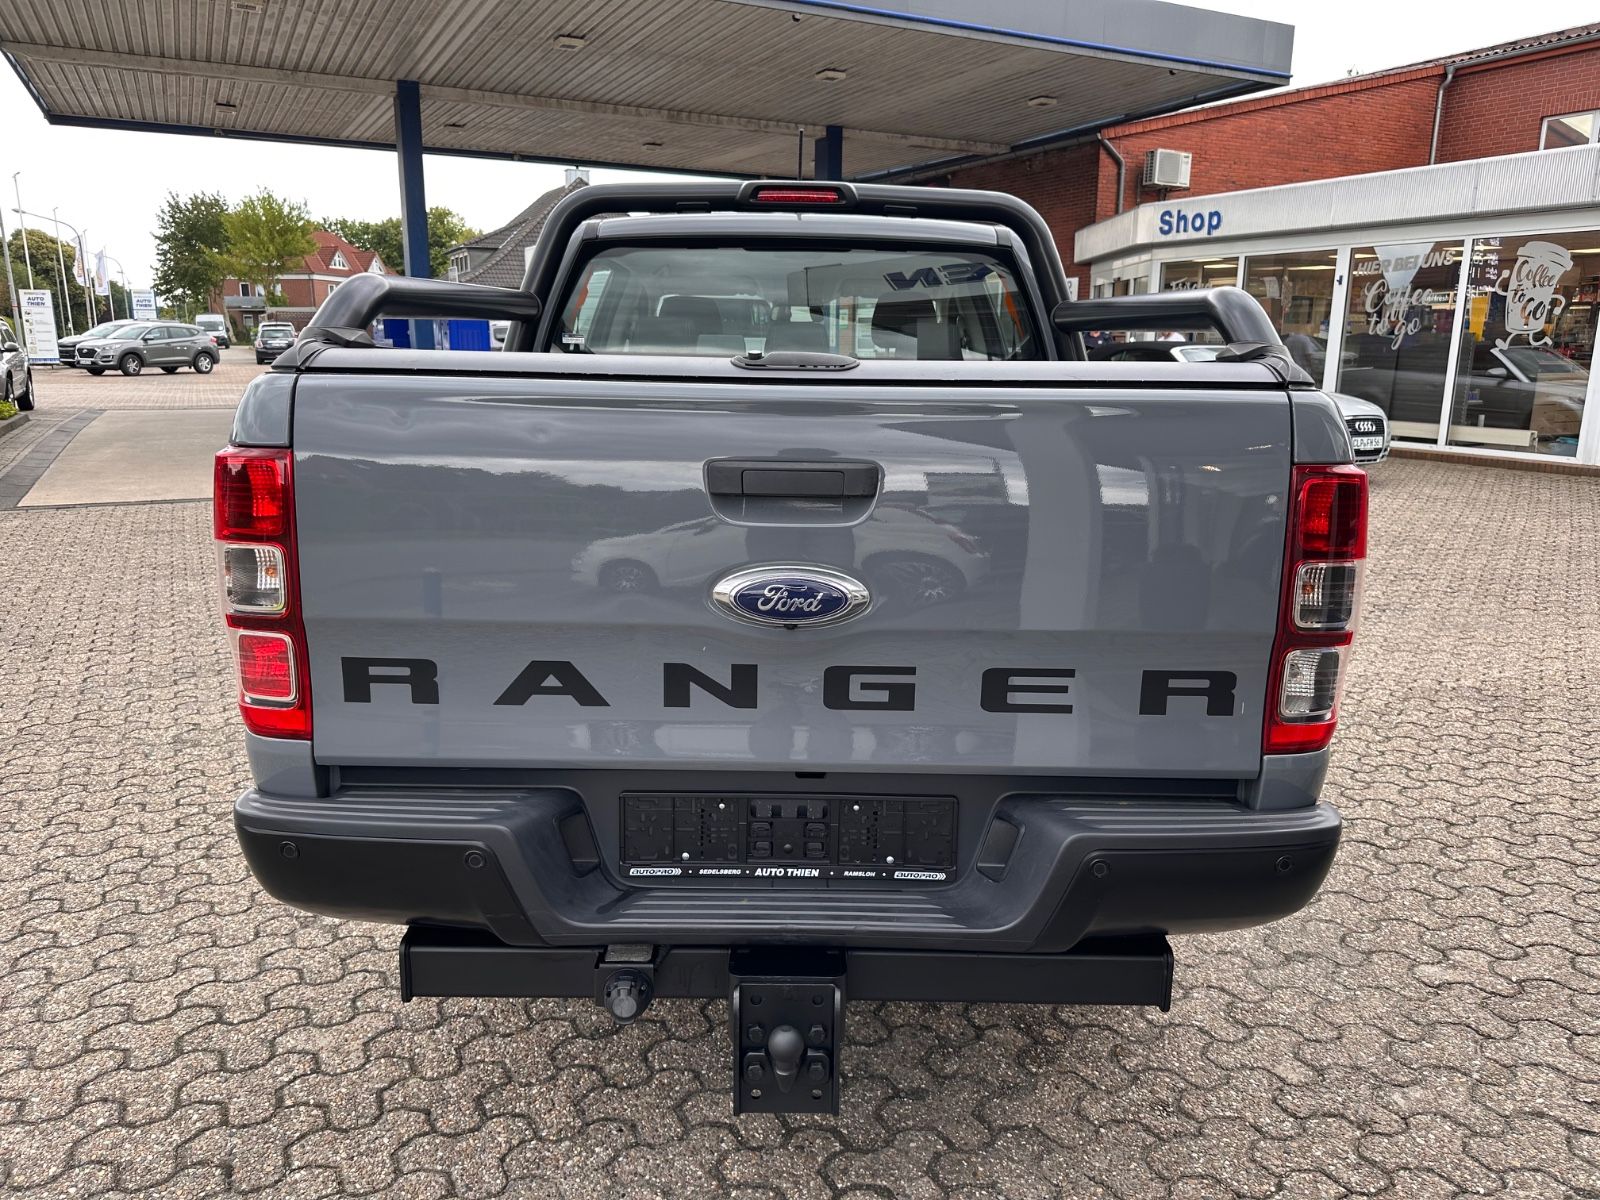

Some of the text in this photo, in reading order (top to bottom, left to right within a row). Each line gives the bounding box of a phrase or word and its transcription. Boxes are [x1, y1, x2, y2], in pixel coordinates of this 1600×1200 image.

[1159, 210, 1221, 235] Shop
[1357, 260, 1390, 276] HIER
[1392, 254, 1420, 272] BEI
[1421, 250, 1456, 268] UNS
[1516, 260, 1556, 288] Coffee
[1365, 279, 1433, 321] Coffee
[1510, 284, 1526, 304] to
[1368, 313, 1421, 350] to go
[757, 584, 823, 612] Ford
[340, 656, 1238, 717] RANGER
[755, 868, 784, 876] AUTO
[786, 868, 820, 877] THIEN
